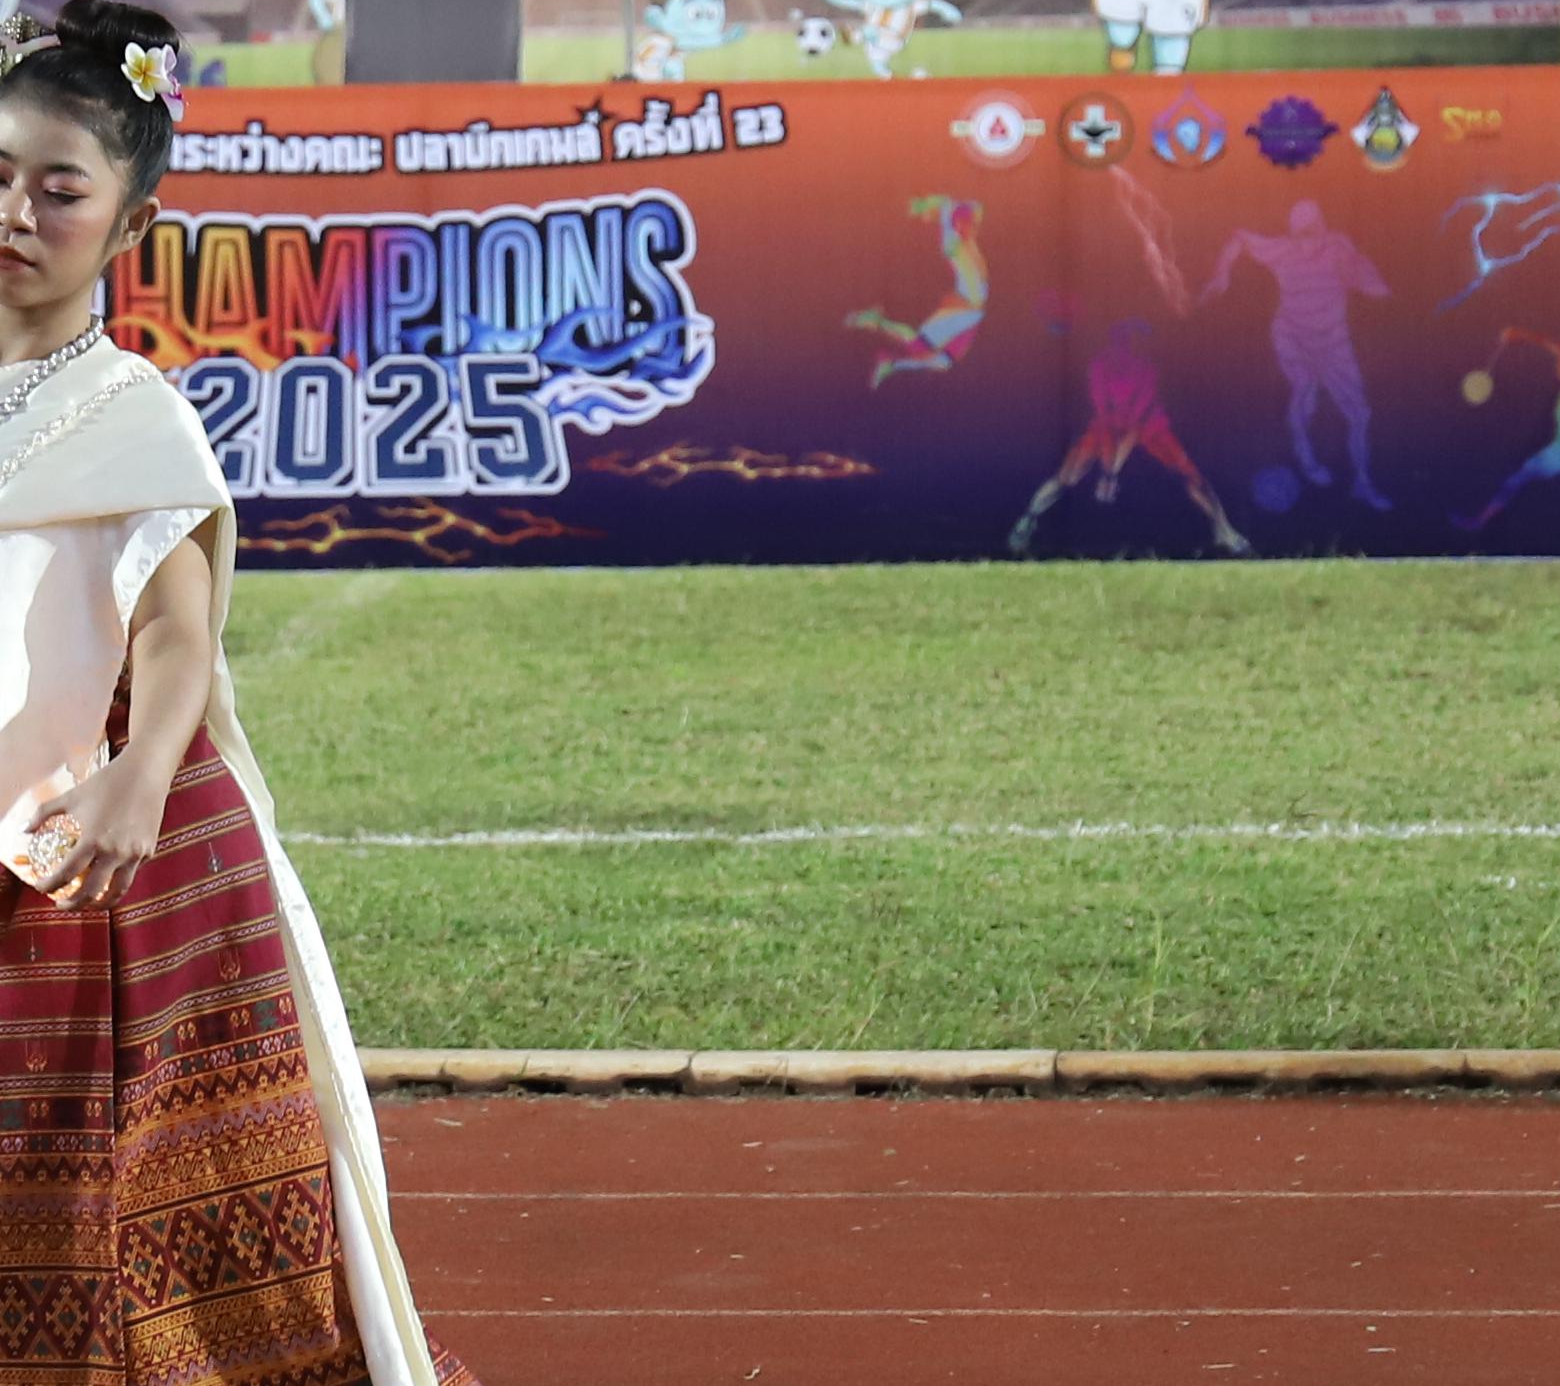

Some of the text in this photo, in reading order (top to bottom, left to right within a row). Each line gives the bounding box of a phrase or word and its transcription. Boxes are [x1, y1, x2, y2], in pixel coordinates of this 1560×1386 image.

[393, 110, 603, 173] ปลาบึกเกมส์
[611, 90, 725, 161] ครั้งที่
[732, 103, 788, 150] 23
[110, 196, 686, 363] HAMPIONS
[183, 357, 562, 490] 2025
